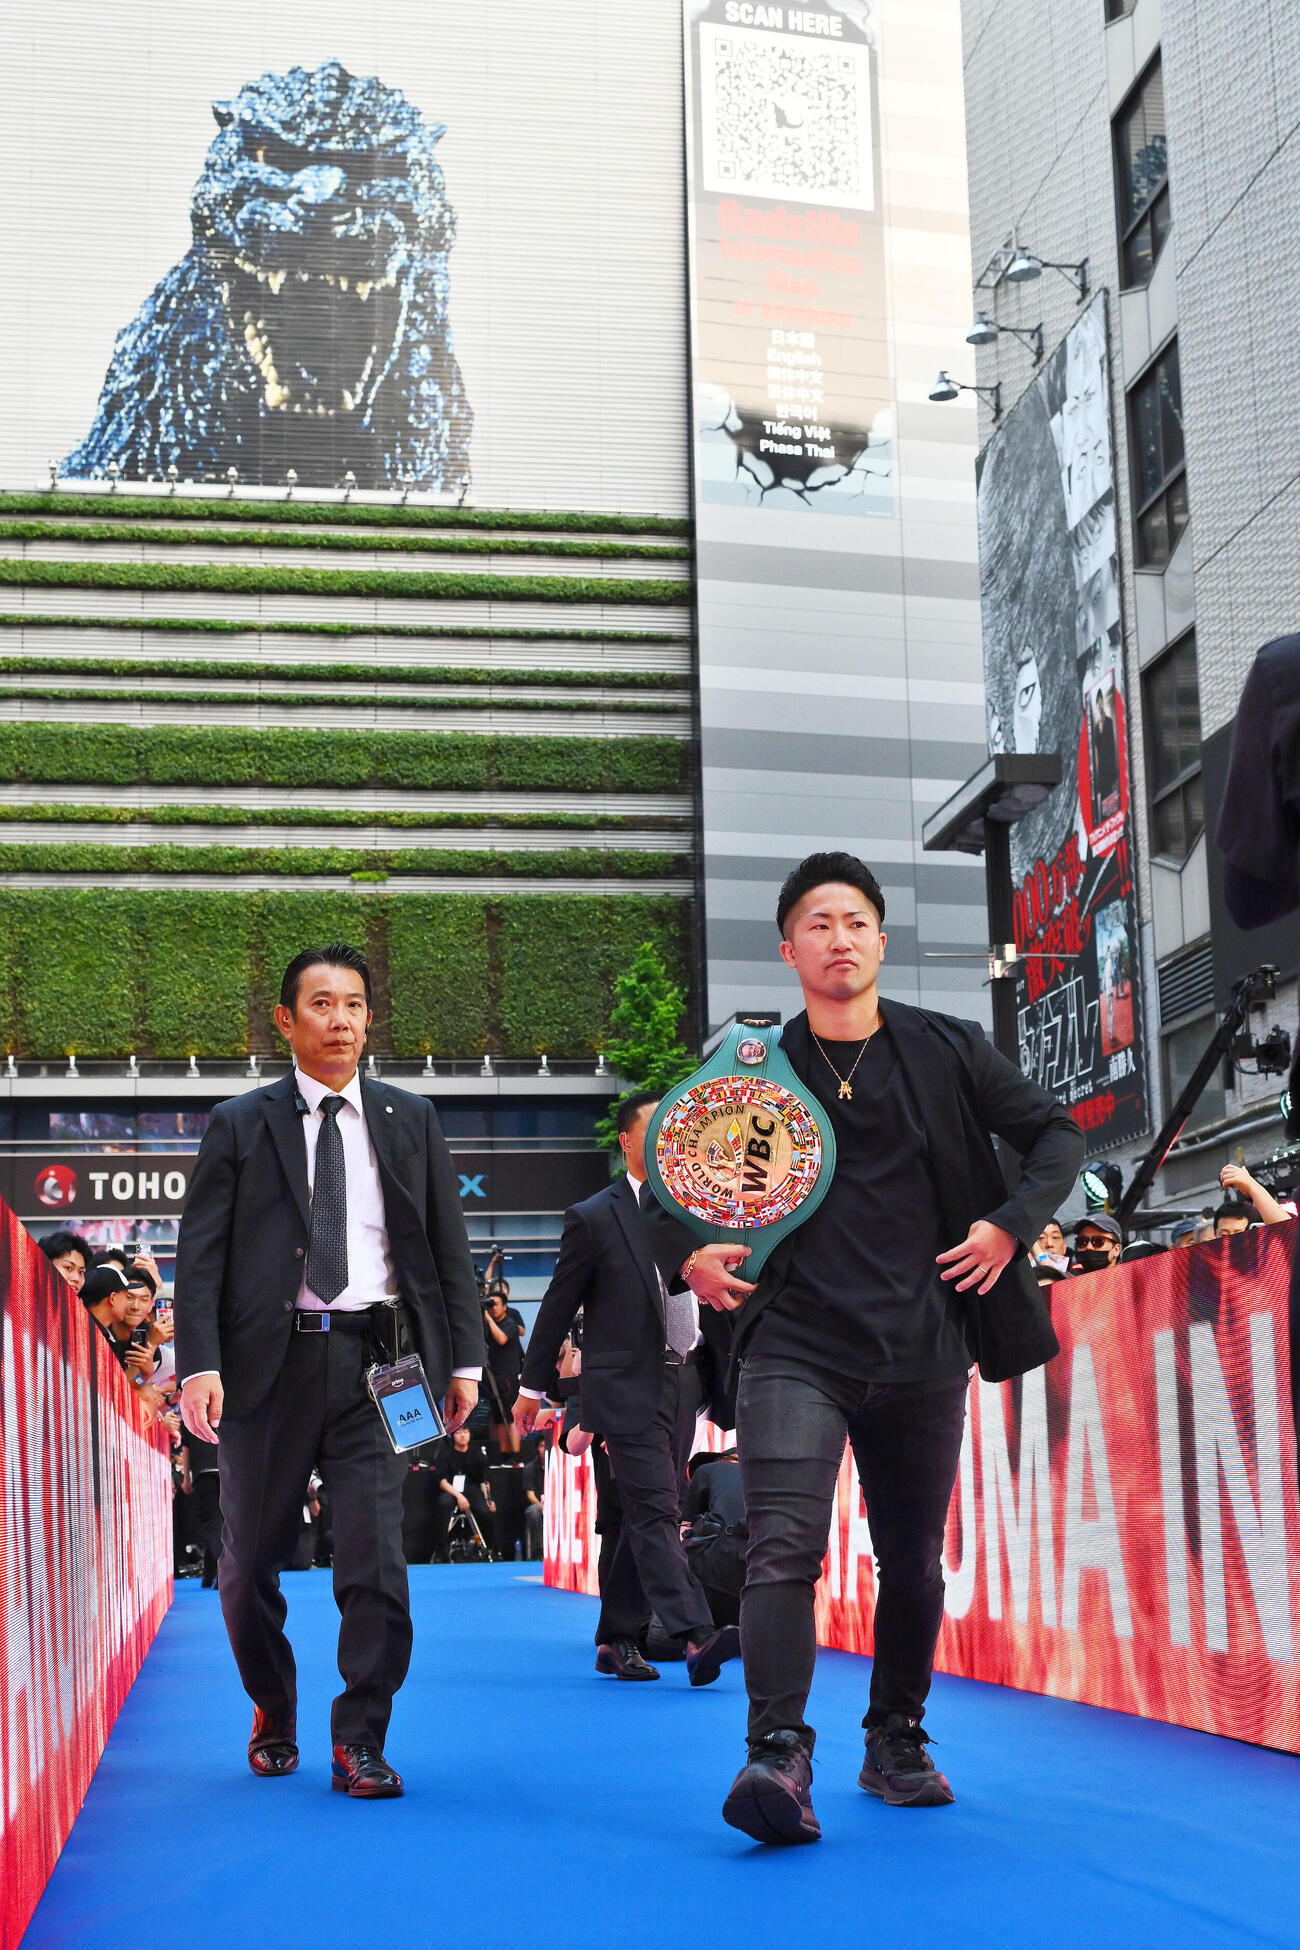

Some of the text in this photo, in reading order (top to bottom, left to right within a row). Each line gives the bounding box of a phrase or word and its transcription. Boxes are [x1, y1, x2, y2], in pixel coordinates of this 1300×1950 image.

[725, 1, 843, 37] SCAN HERE
[718, 199, 862, 248] Godzilla
[766, 269, 819, 302] Map
[767, 348, 822, 367] English
[804, 443, 835, 459] Thai
[688, 1104, 745, 1200] WORLD CHAMPION
[741, 1115, 776, 1193] WBC
[88, 1171, 187, 1200] TOHO
[399, 1408, 422, 1422] AAA
